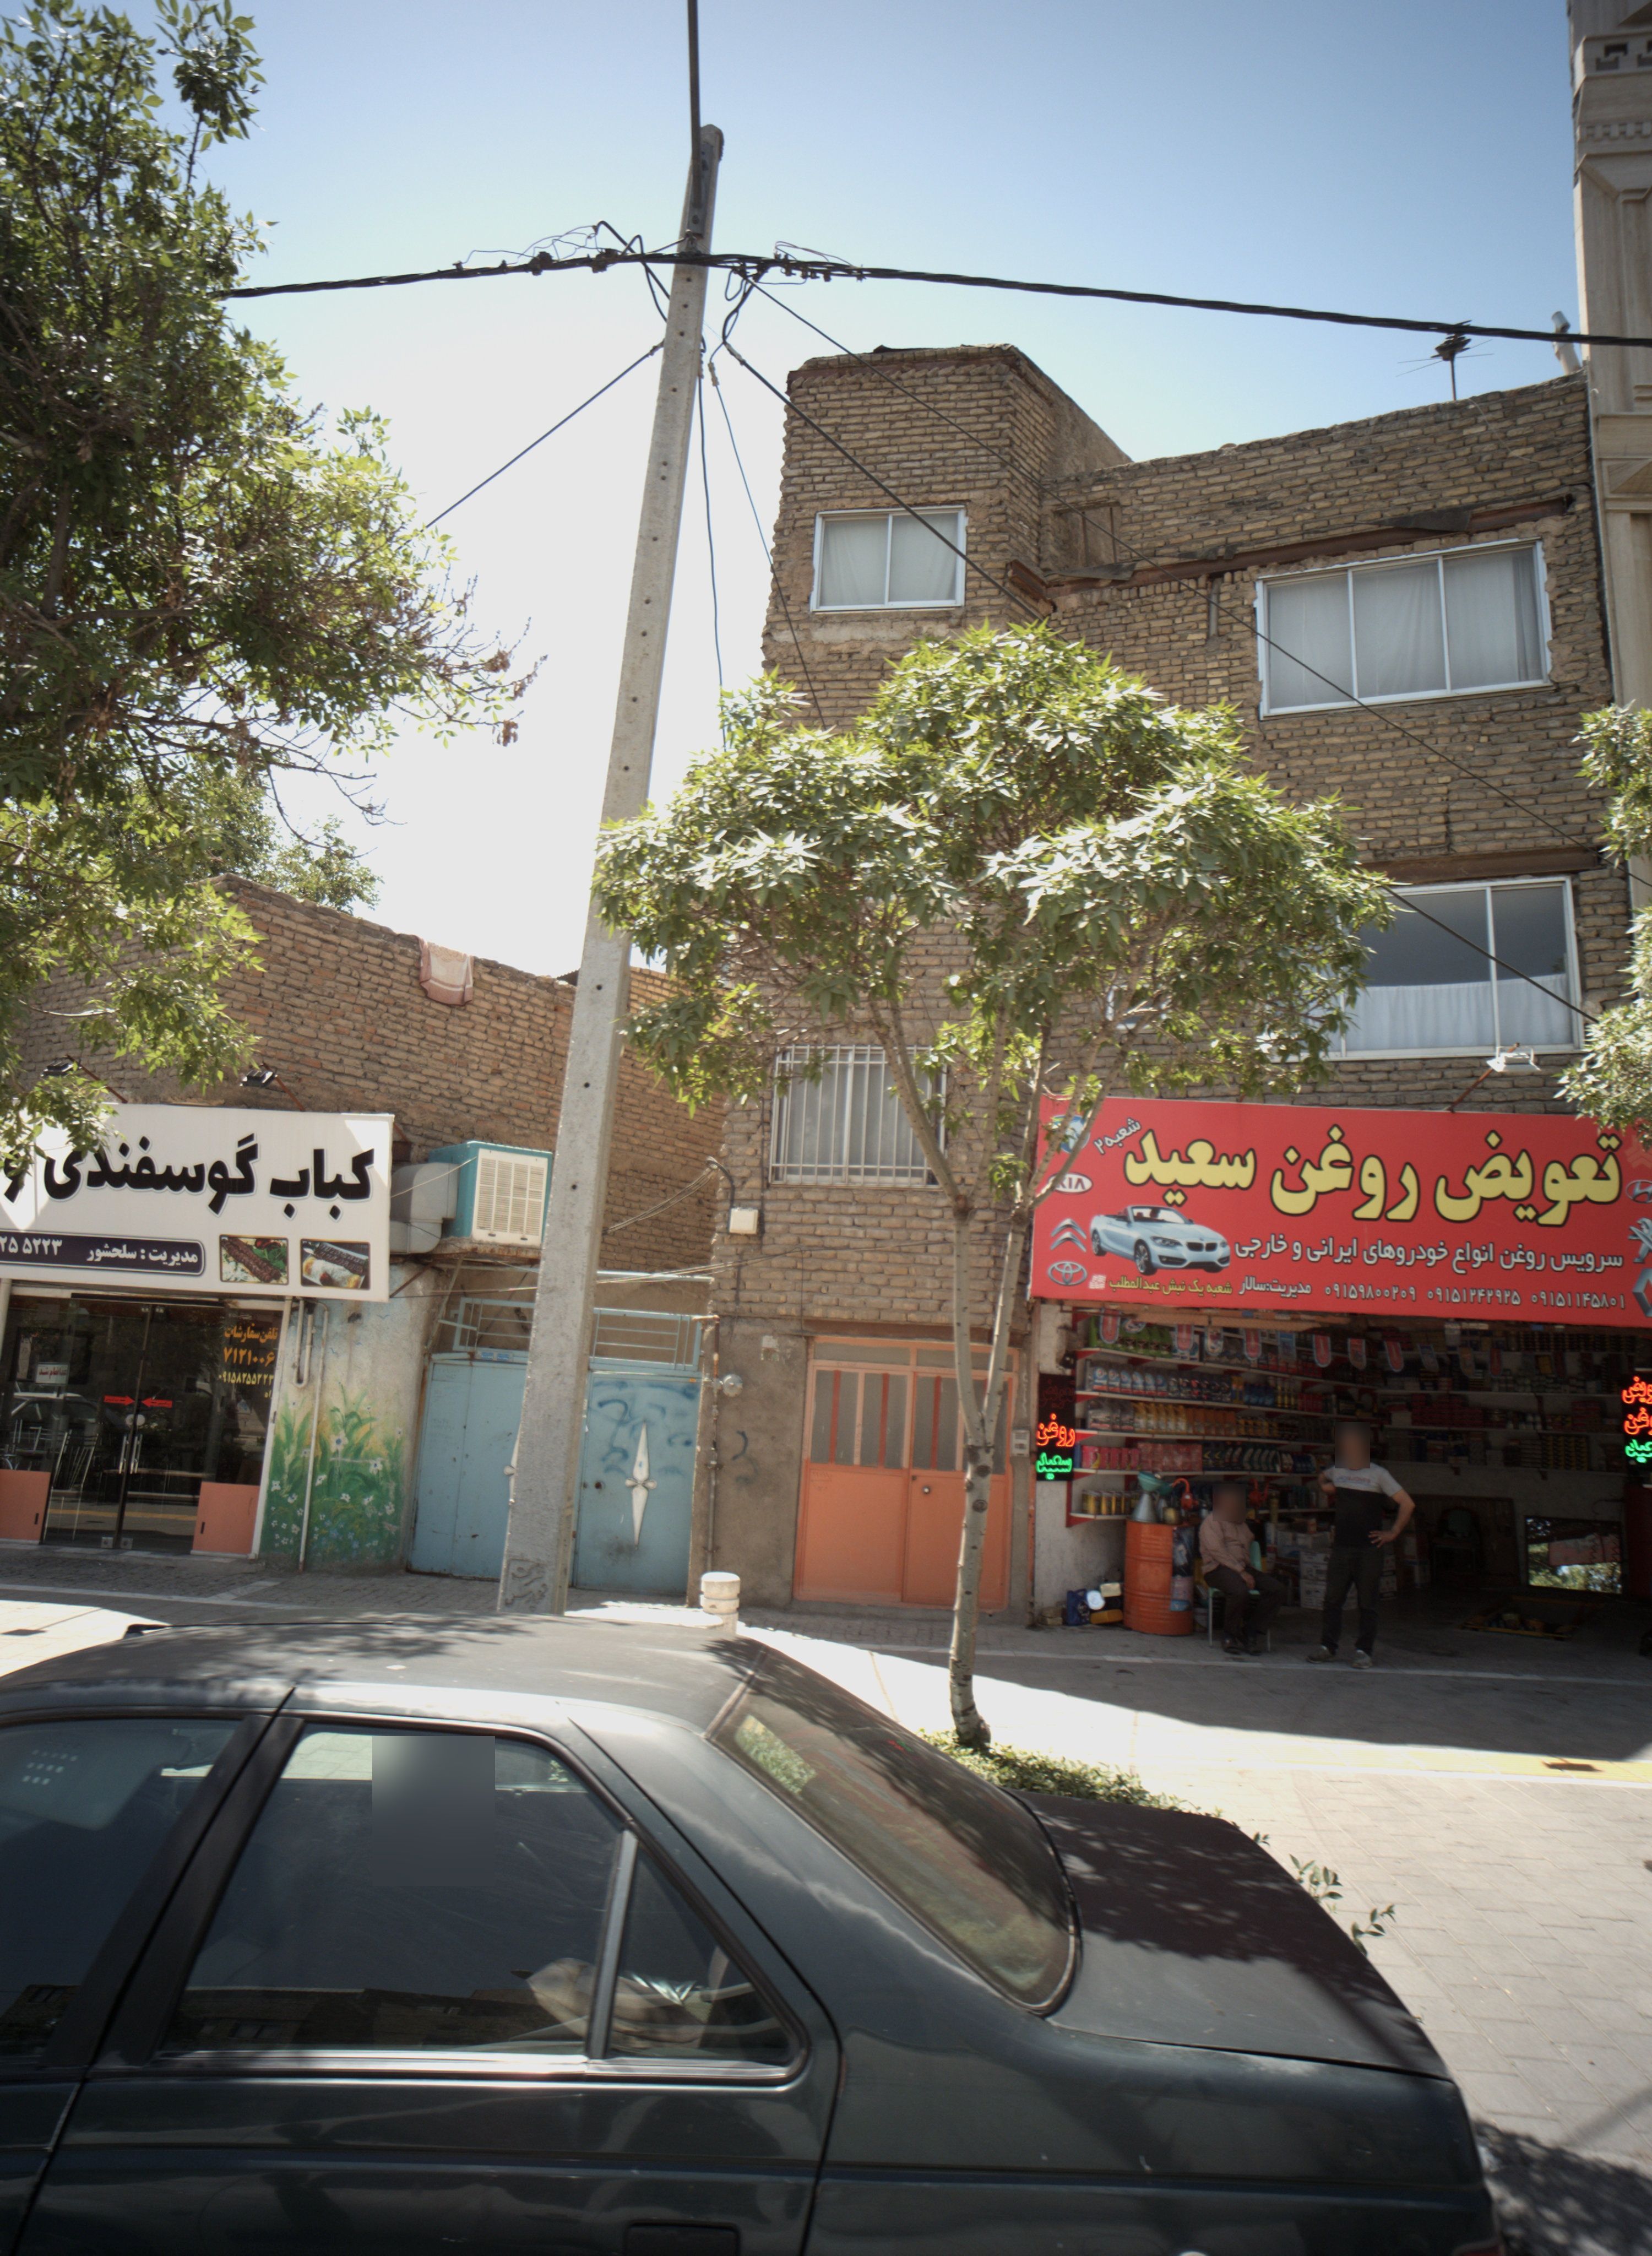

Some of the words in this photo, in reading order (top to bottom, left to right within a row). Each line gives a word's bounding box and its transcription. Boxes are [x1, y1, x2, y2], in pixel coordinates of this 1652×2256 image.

[1104, 1117, 1141, 1148] شعبه
[44, 1132, 259, 1215] گوسفندی
[1124, 1129, 1257, 1207] سعید
[1270, 1124, 1420, 1222] روغن
[1434, 1130, 1622, 1227] تعویض
[269, 1148, 374, 1221] کباب
[23, 1237, 63, 1256] ۵۲۲۳
[86, 1243, 137, 1261] سلحشور
[149, 1248, 198, 1266] مدیریت
[1235, 1233, 1288, 1259] خارجی
[1291, 1239, 1302, 1261] و
[1306, 1237, 1357, 1263] ایرانی
[1362, 1238, 1448, 1267] خودروهای
[1500, 1243, 1546, 1271] روغن
[1452, 1241, 1494, 1274] انواع
[1550, 1252, 1623, 1273] سرویس
[1108, 1276, 1160, 1292] عبدالمطلب
[1162, 1278, 1186, 1295] نبش
[1188, 1278, 1205, 1297] یک
[1207, 1282, 1232, 1297] شعبه
[1324, 1281, 1417, 1301] ۰۹۱۵۹۸۰۰۲۰۹
[1427, 1287, 1521, 1306] ۰۹۱۵۱۲۴۲۹۲۵
[1531, 1290, 1625, 1310] ۰۹۱۵۱۱۴۵۸۰۱
[259, 1326, 278, 1343] تلفن
[1036, 1412, 1076, 1447] روغن
